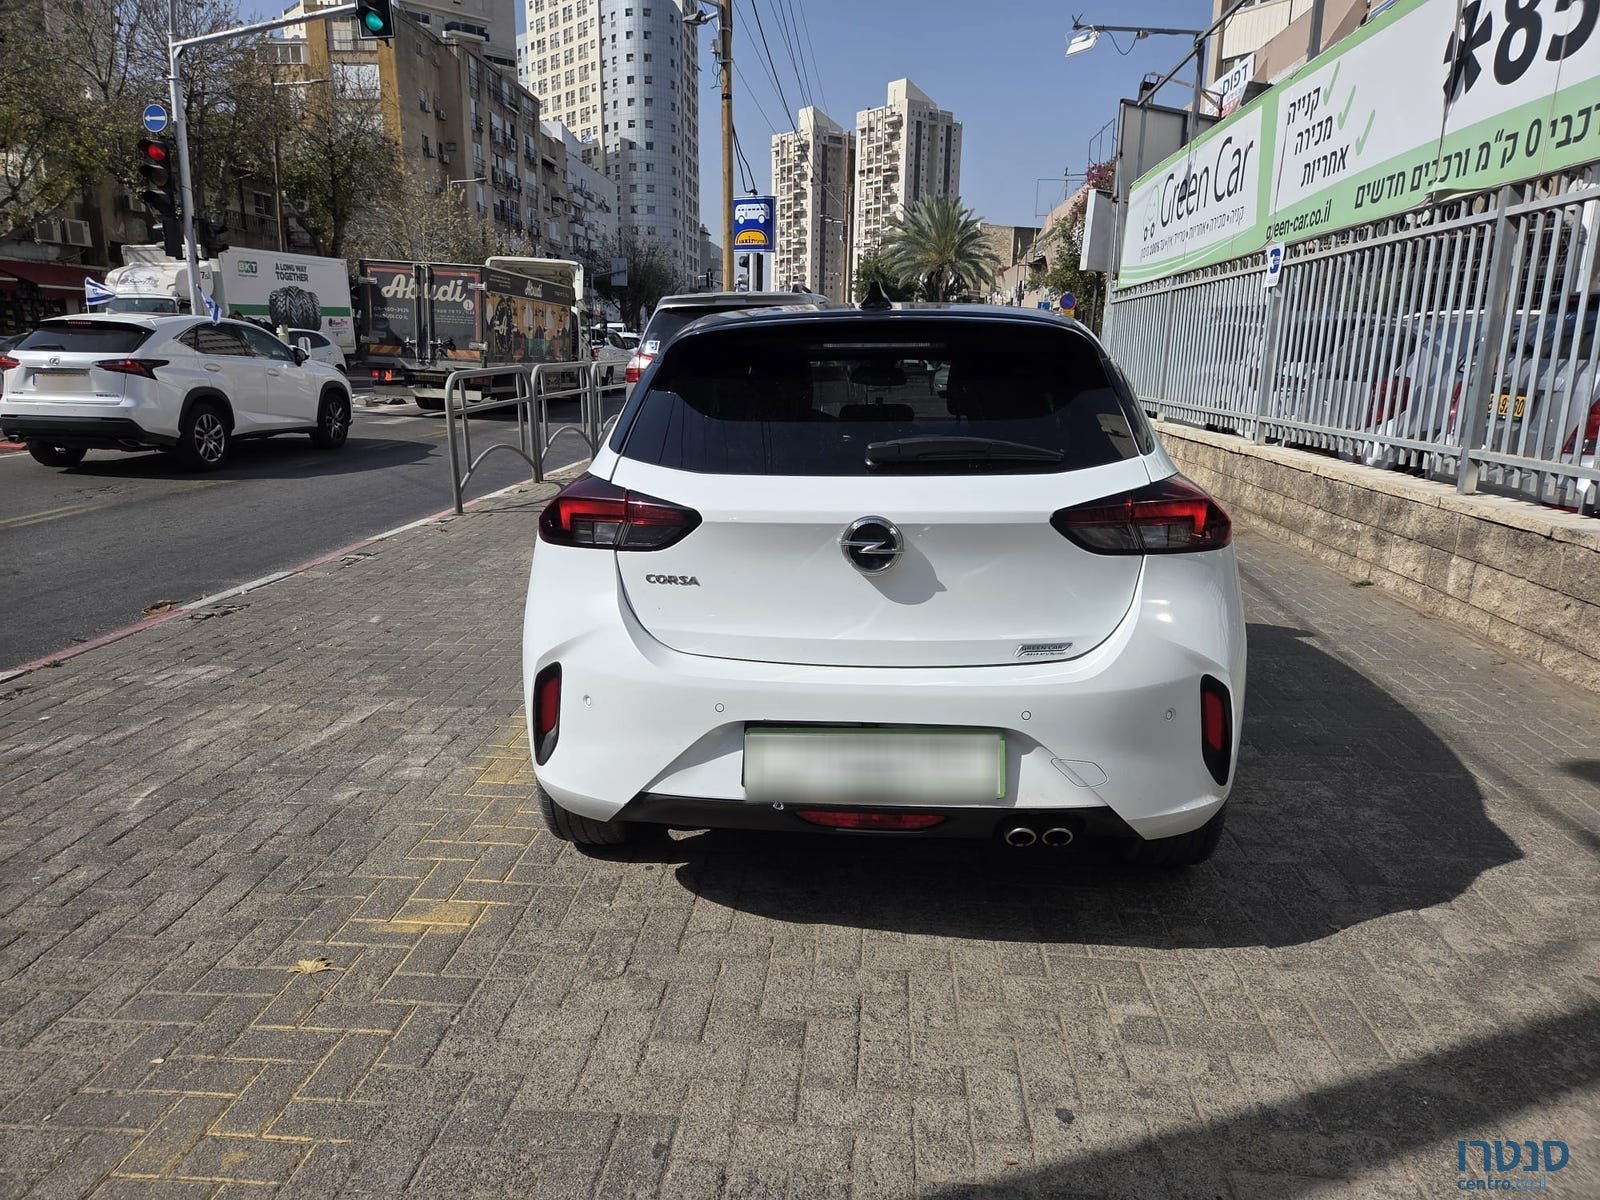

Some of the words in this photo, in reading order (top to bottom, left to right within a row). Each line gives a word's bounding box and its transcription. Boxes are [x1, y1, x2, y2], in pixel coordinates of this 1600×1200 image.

[1223, 62, 1248, 96] דפוס
[1287, 85, 1321, 127] קנייה
[1294, 117, 1334, 156] מכירה
[1160, 165, 1209, 227] Green
[1214, 136, 1254, 202] Car
[1301, 144, 1350, 188] אחריות
[1410, 148, 1470, 192] ורכבים
[1354, 170, 1406, 209] חדשים
[1266, 199, 1332, 240] geen-car.co.il
[238, 261, 257, 273] BKT
[275, 271, 308, 282] TOGETHER
[280, 263, 295, 272] LONG
[296, 264, 307, 273] WAY
[645, 574, 701, 586] CORSA
